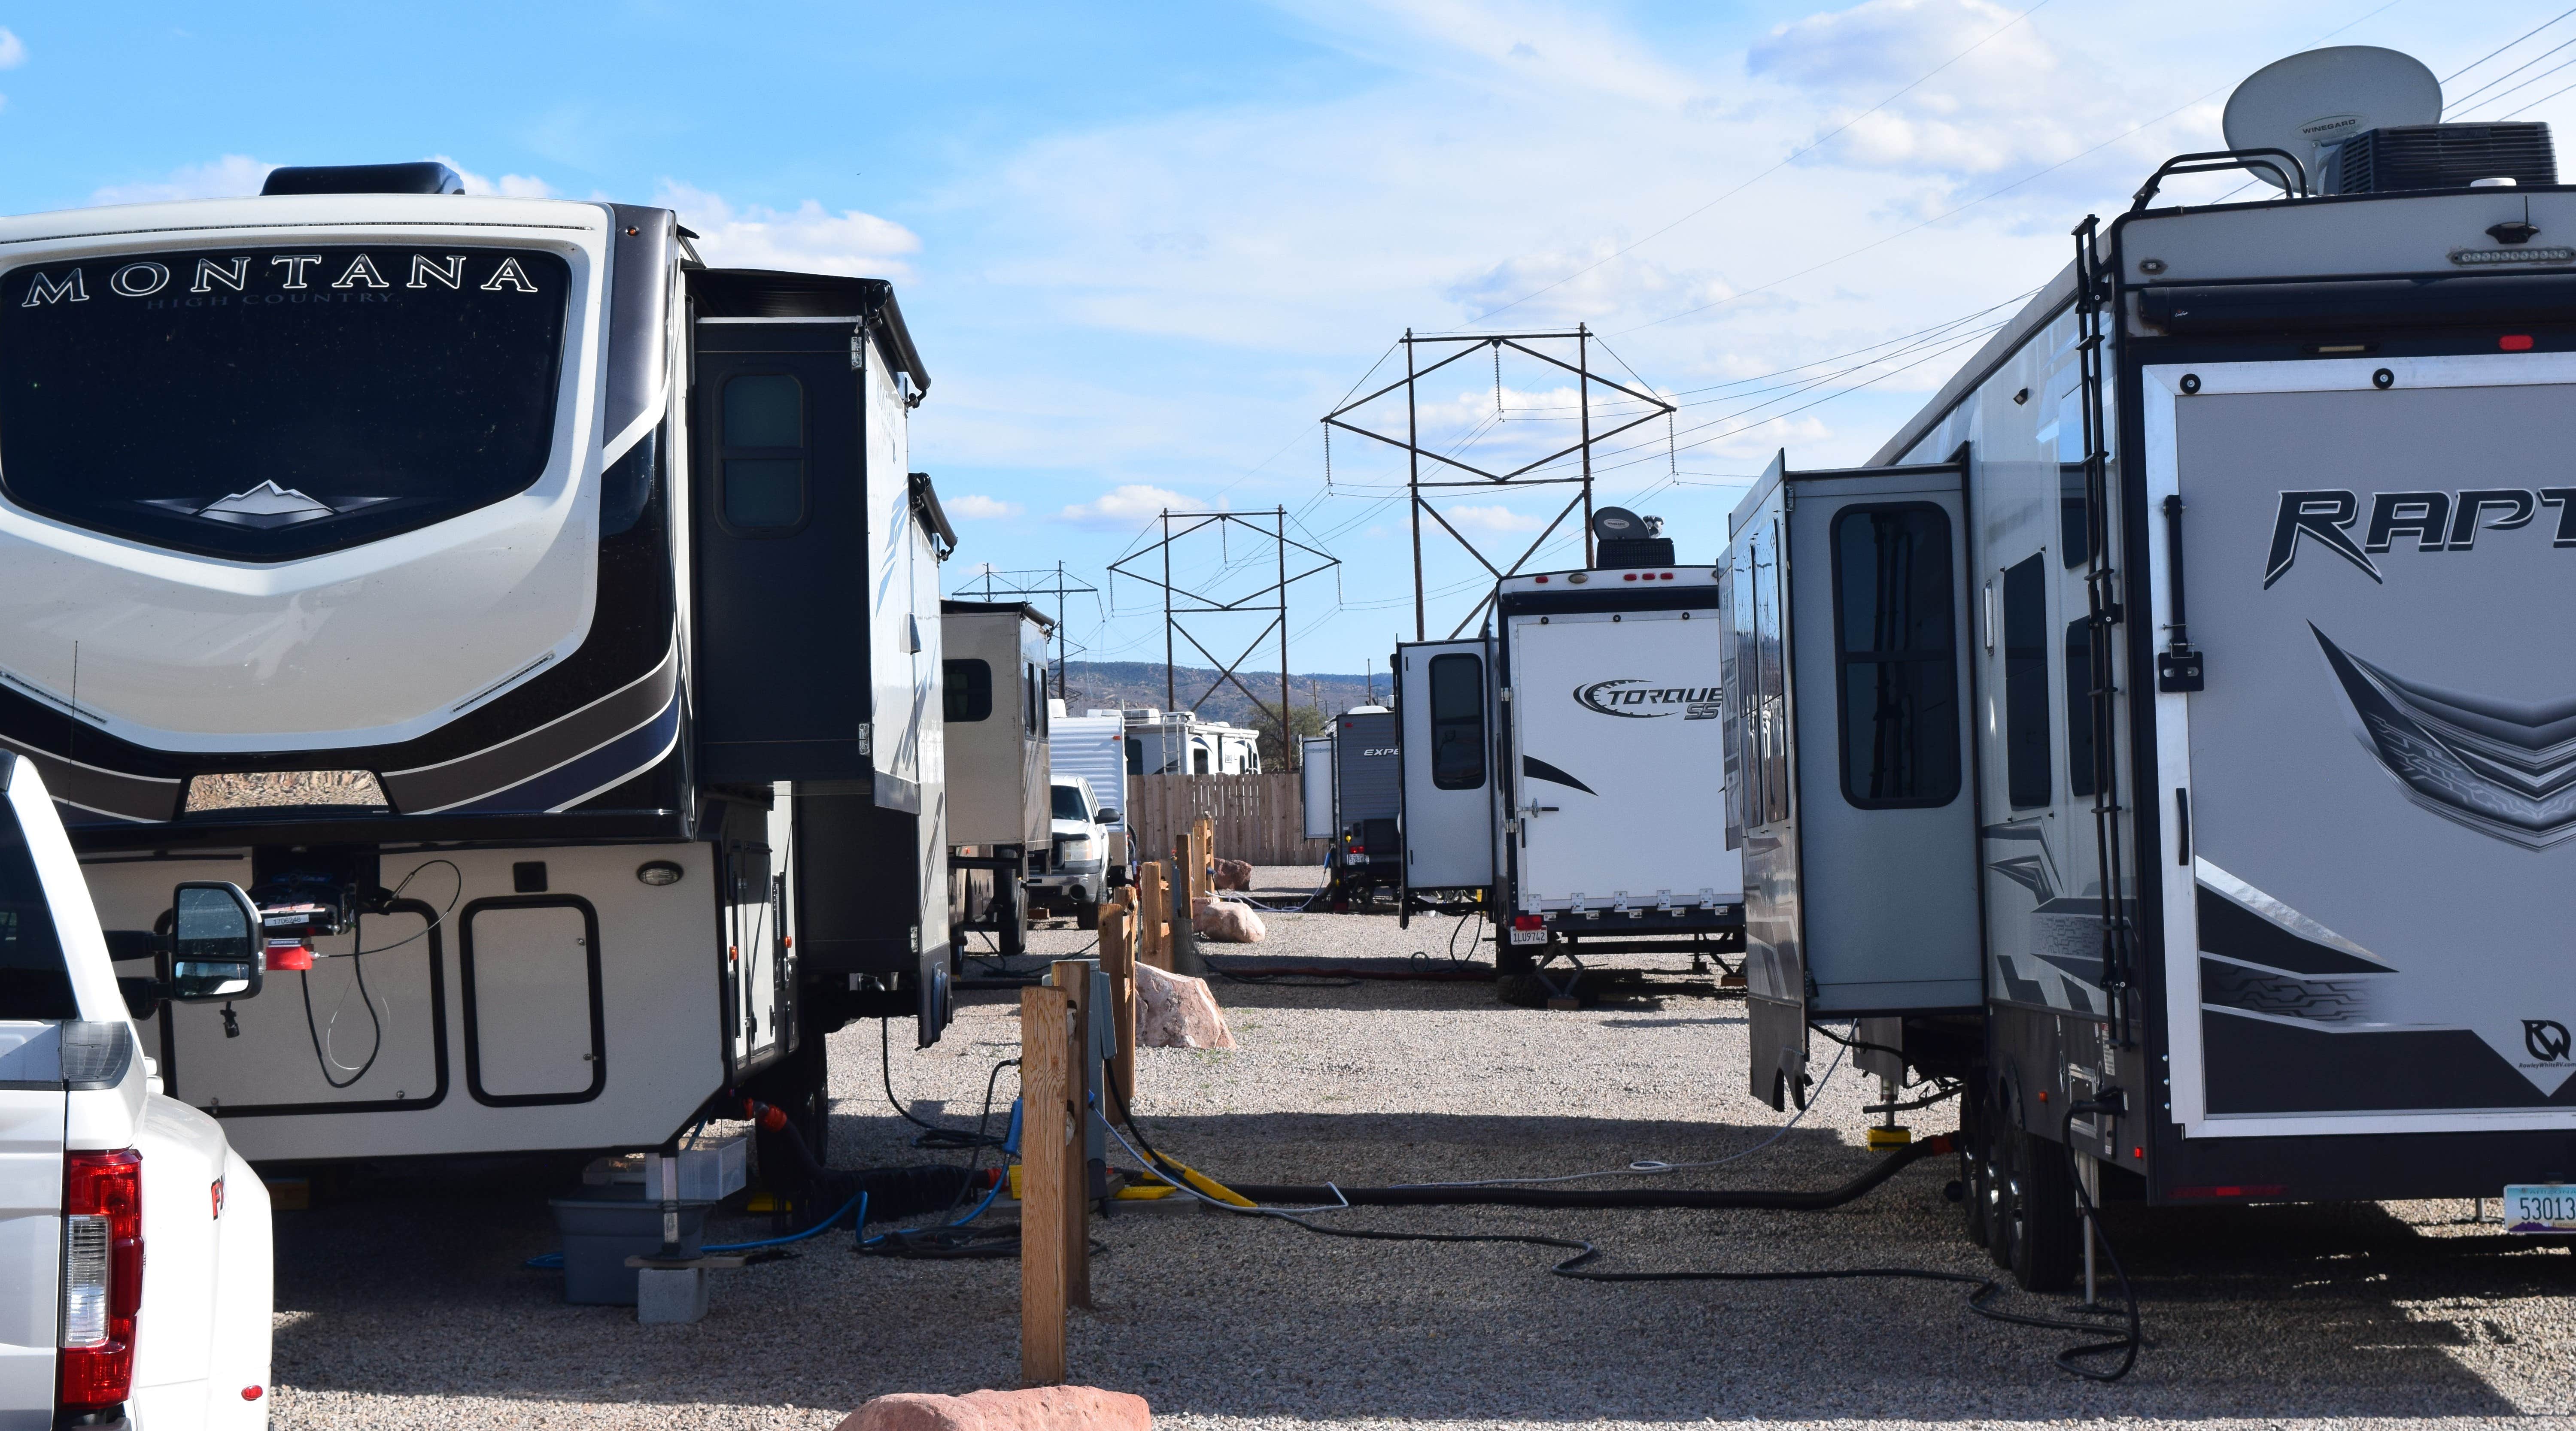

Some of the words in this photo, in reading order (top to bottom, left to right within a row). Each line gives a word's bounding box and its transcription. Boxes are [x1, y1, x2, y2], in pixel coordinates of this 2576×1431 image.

[2303, 119, 2356, 134] WINEGARD
[22, 253, 538, 307] MONTANA
[147, 296, 228, 309] HIGH
[242, 292, 395, 304] COUNTRY
[1607, 687, 1722, 705] TORQUE
[1684, 702, 1721, 720] SS
[273, 916, 301, 925] 1706248
[1513, 932, 1546, 942] 1LU9742
[2520, 1197, 2576, 1220] 53013
